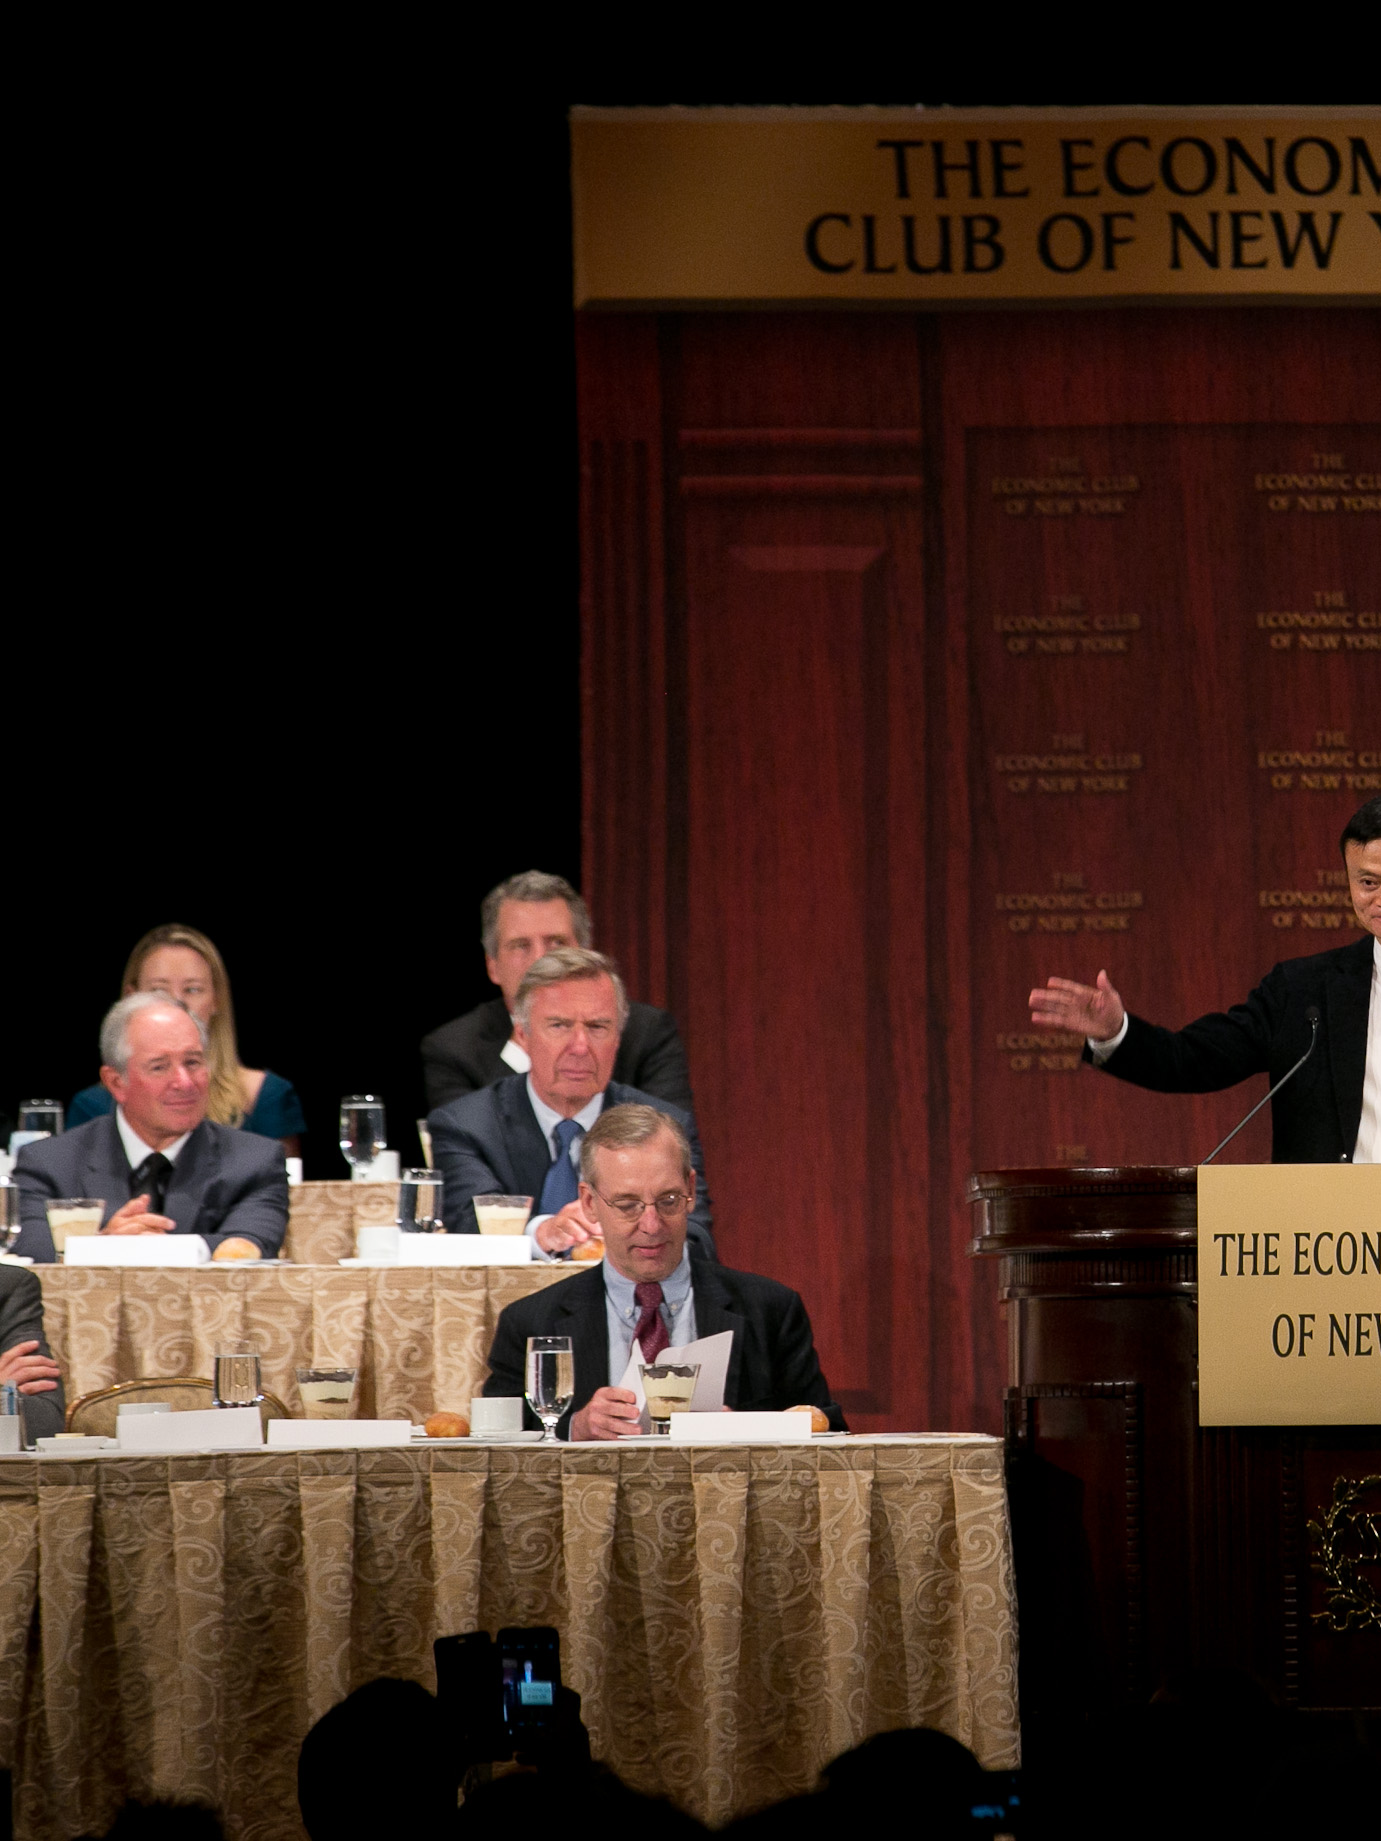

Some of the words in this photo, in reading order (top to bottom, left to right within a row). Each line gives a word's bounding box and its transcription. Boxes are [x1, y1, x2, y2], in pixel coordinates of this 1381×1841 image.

[875, 139, 1032, 199] THE
[802, 212, 1008, 276] CLUB
[1036, 212, 1139, 275] OF
[1168, 210, 1345, 273] NEW
[1255, 474, 1350, 490] ECONOMIC
[1269, 497, 1291, 512] OF
[1299, 497, 1339, 511] NEW
[1257, 613, 1352, 628] ECONOMIC
[1270, 635, 1292, 649] OF
[1300, 635, 1340, 649] NEW
[1258, 752, 1354, 768] ECONOMIC
[1271, 775, 1294, 789] OF
[1301, 775, 1342, 789] NEW
[1272, 913, 1295, 928] OF
[1303, 913, 1342, 928] NEW
[1214, 1233, 1280, 1276] THE
[1272, 1314, 1315, 1358] OF
